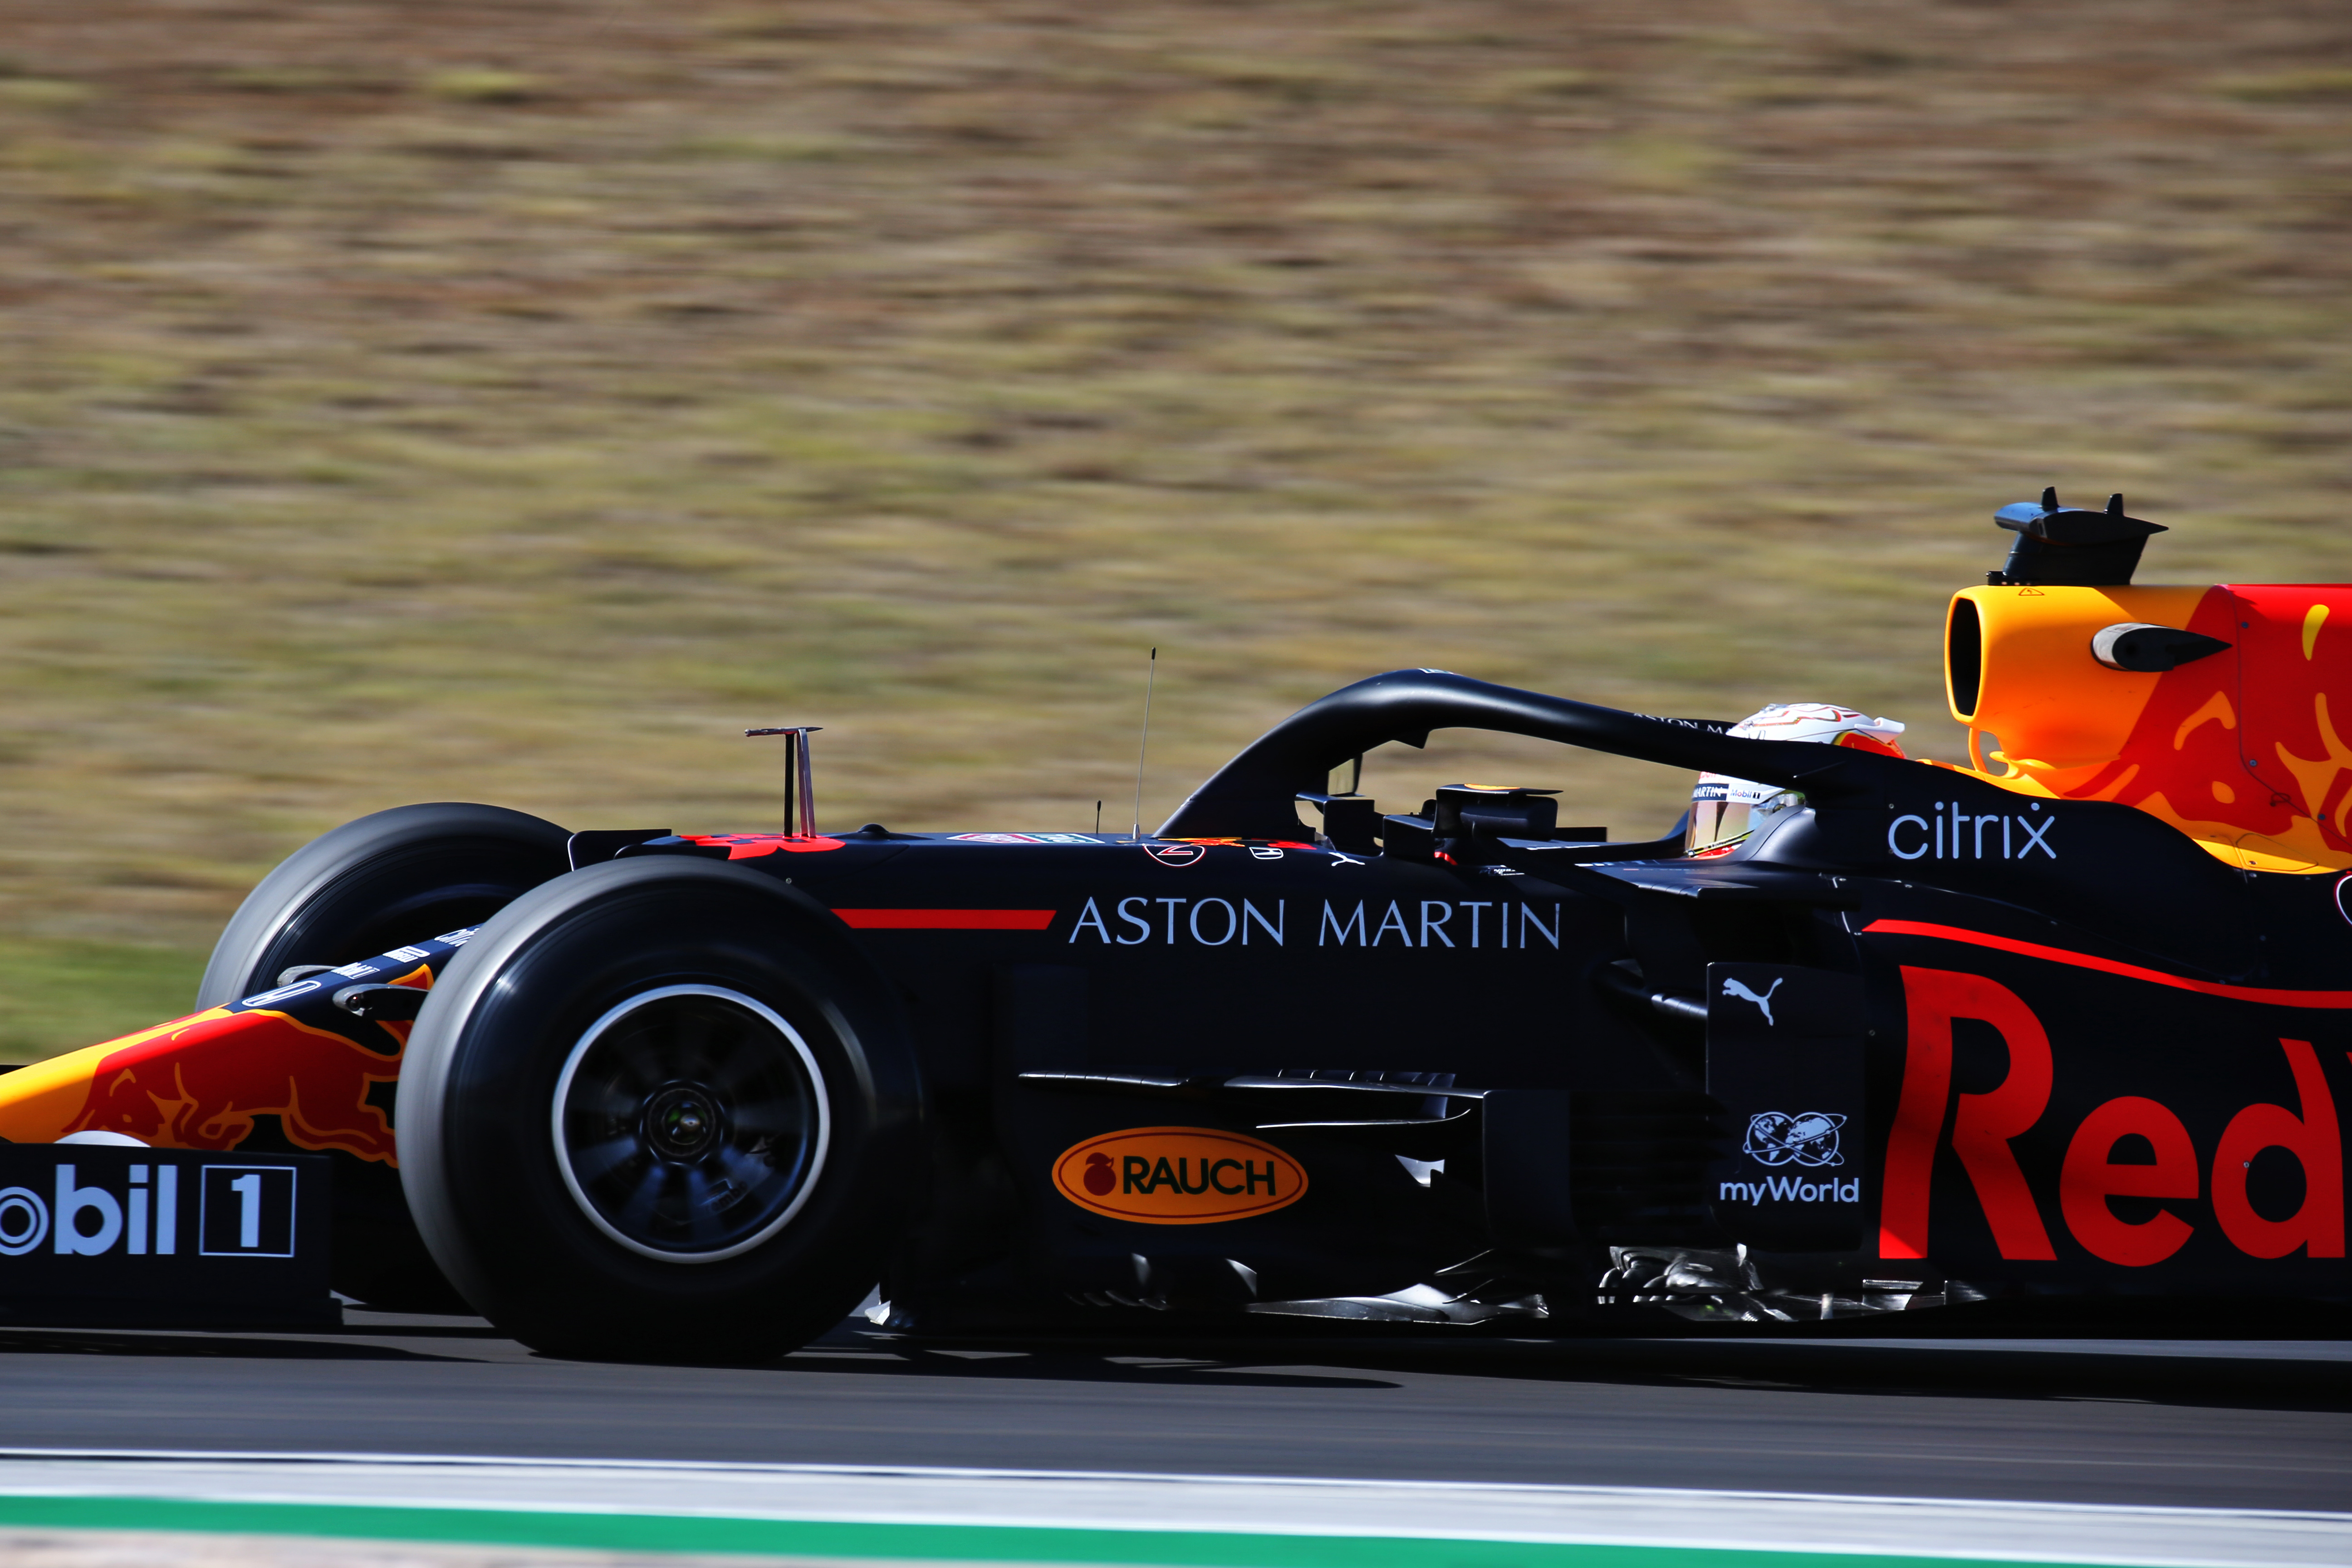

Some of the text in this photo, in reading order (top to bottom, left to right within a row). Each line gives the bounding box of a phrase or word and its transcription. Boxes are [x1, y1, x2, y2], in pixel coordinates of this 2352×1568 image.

[1730, 789, 1753, 798] Mobil
[1888, 801, 2057, 860] citrix
[1068, 896, 1560, 949] ASTON MARTIN
[1878, 965, 2346, 1267] Red
[1123, 1156, 1276, 1196] RAUCH
[1720, 1176, 1859, 1206] myWorld
[231, 1174, 261, 1248] 1
